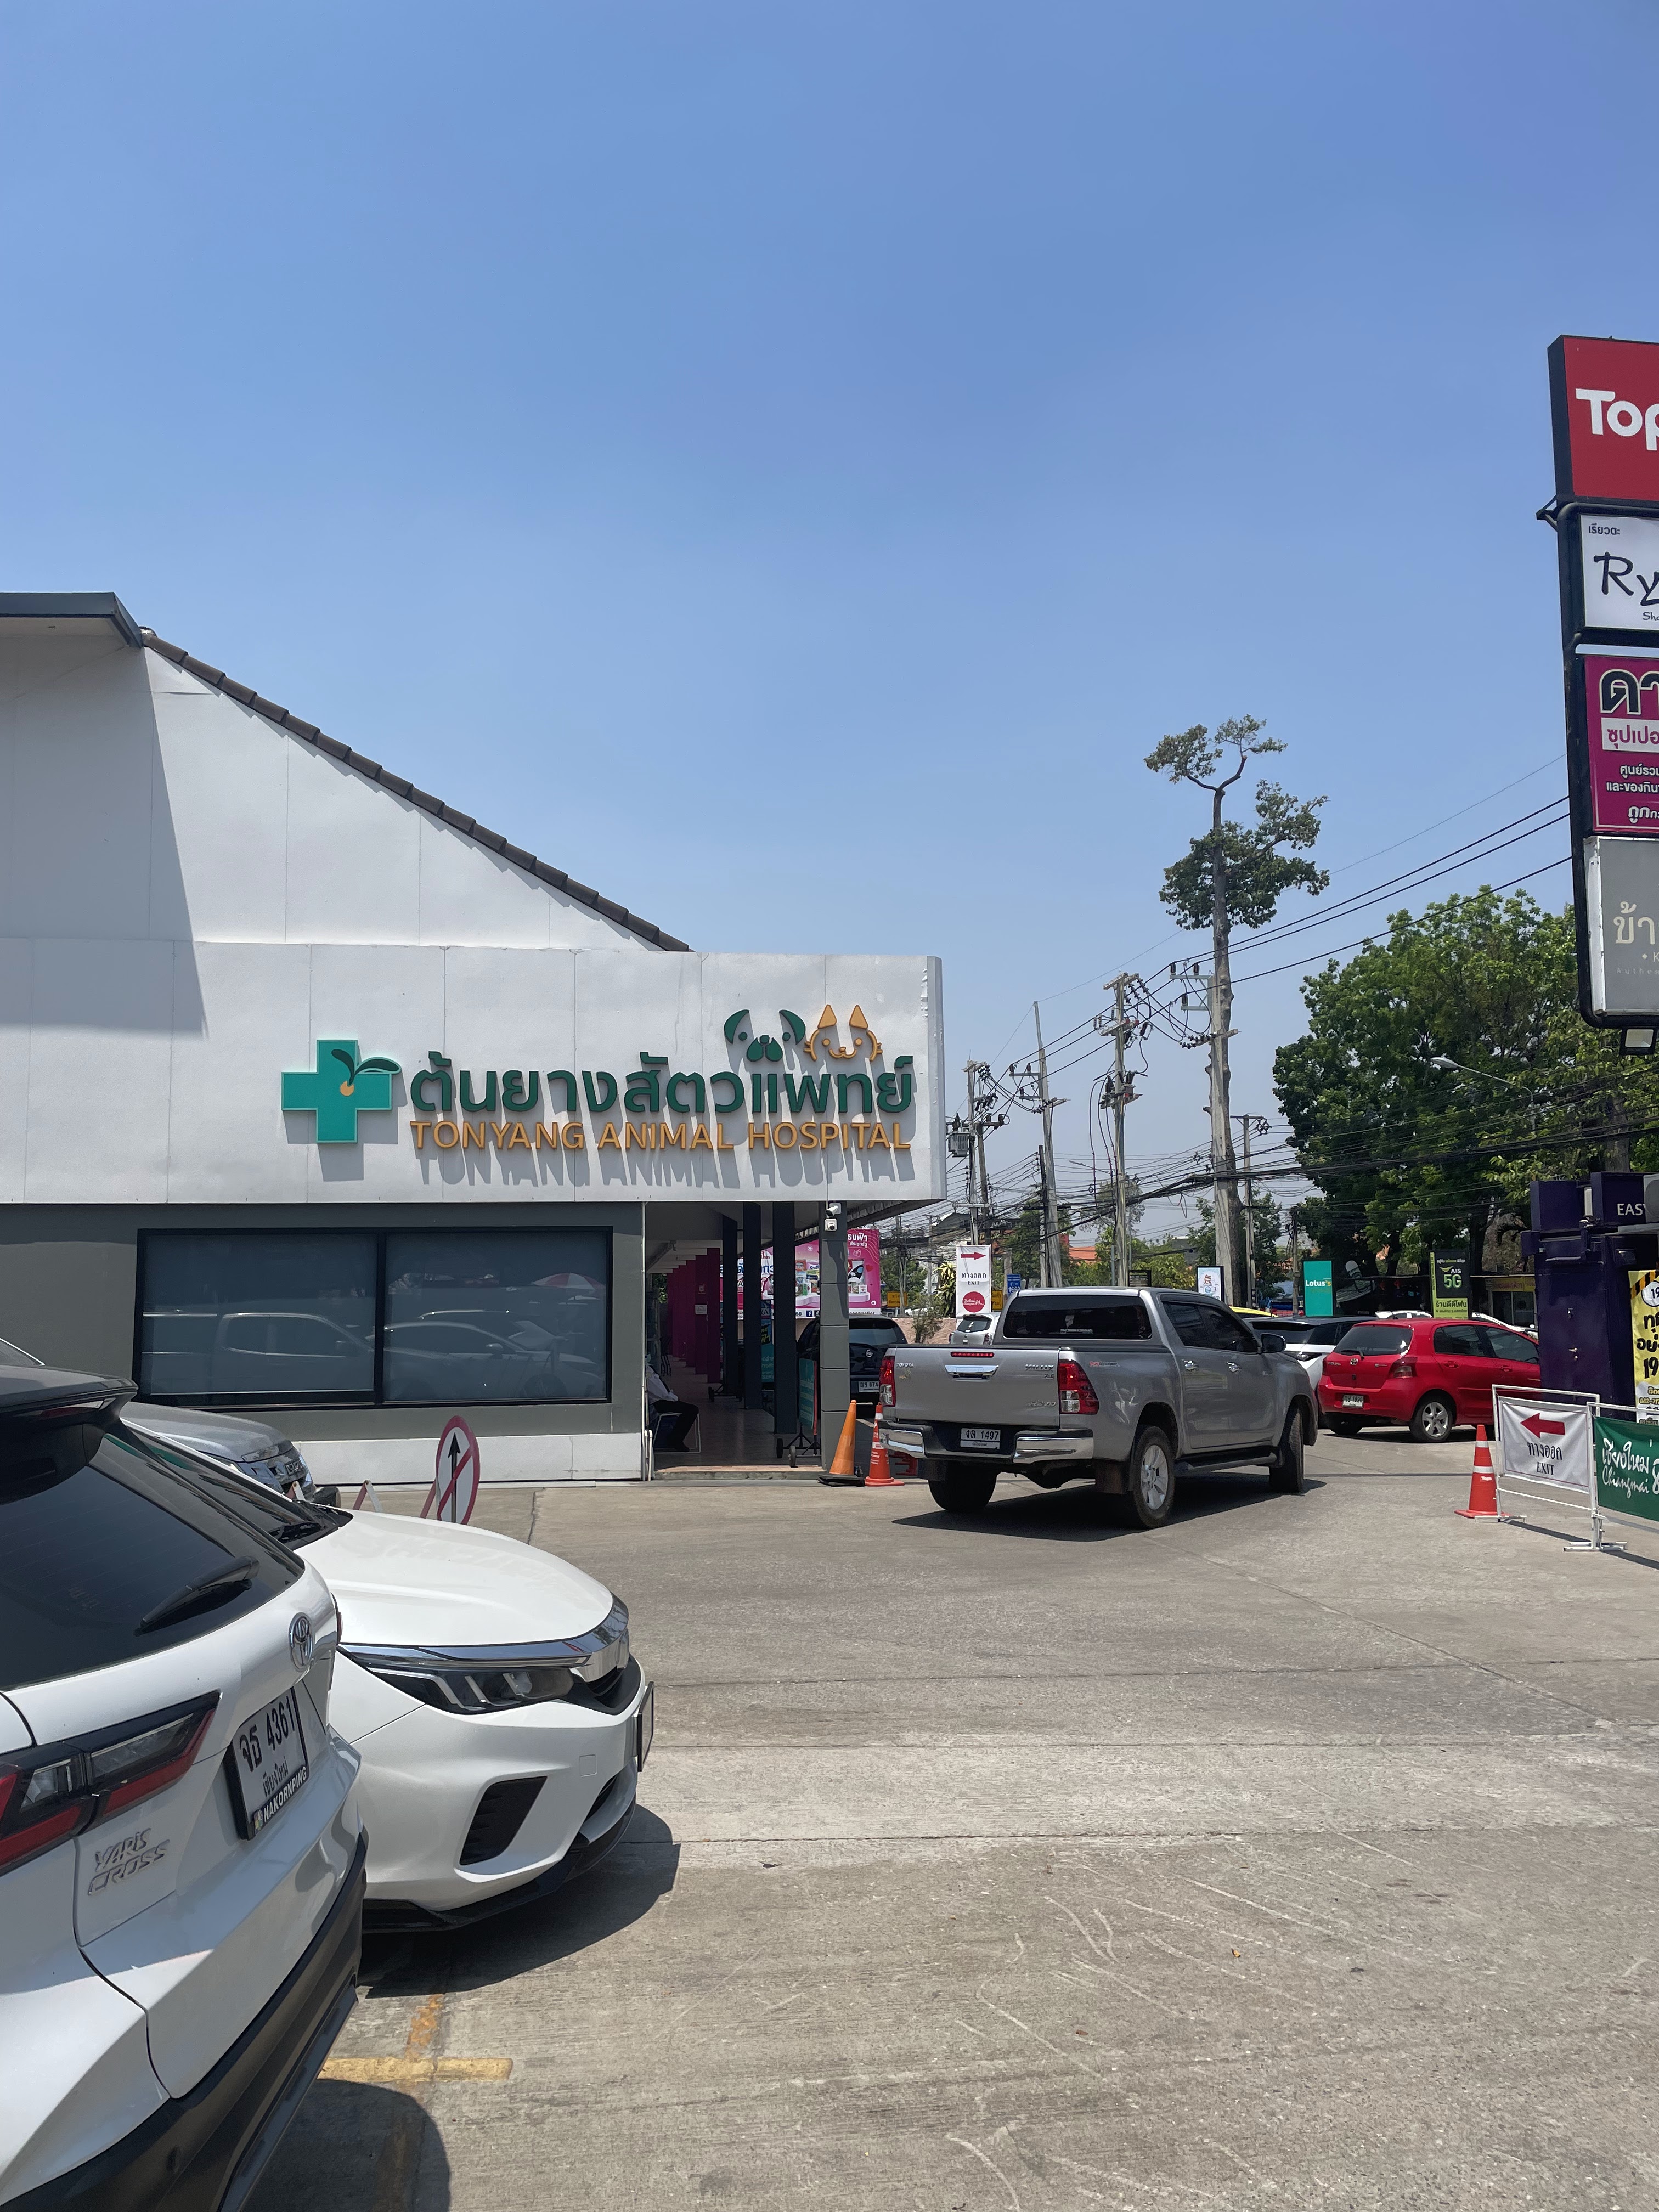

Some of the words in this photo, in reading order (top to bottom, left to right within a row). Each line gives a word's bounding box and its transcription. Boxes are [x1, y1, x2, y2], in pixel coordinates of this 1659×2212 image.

[1606, 782, 1659, 793] และของกิน
[1628, 806, 1659, 823] ถูกก
[410, 1050, 914, 1115] ต้นยางสัตวแพทย์
[410, 1121, 584, 1150] TONYANG
[597, 1121, 734, 1150] ANIMAL
[748, 1121, 911, 1150] HOSPITAL
[1443, 1274, 1462, 1289] 5G
[981, 1431, 998, 1440] 1497
[1527, 1442, 1562, 1460] ทางออก
[1537, 1462, 1555, 1476] EXIT
[266, 1695, 295, 1751] 4361
[263, 1766, 307, 1823] NAKORNPING
[94, 1827, 151, 1872] YARIS
[88, 1839, 170, 1896] CROSS
